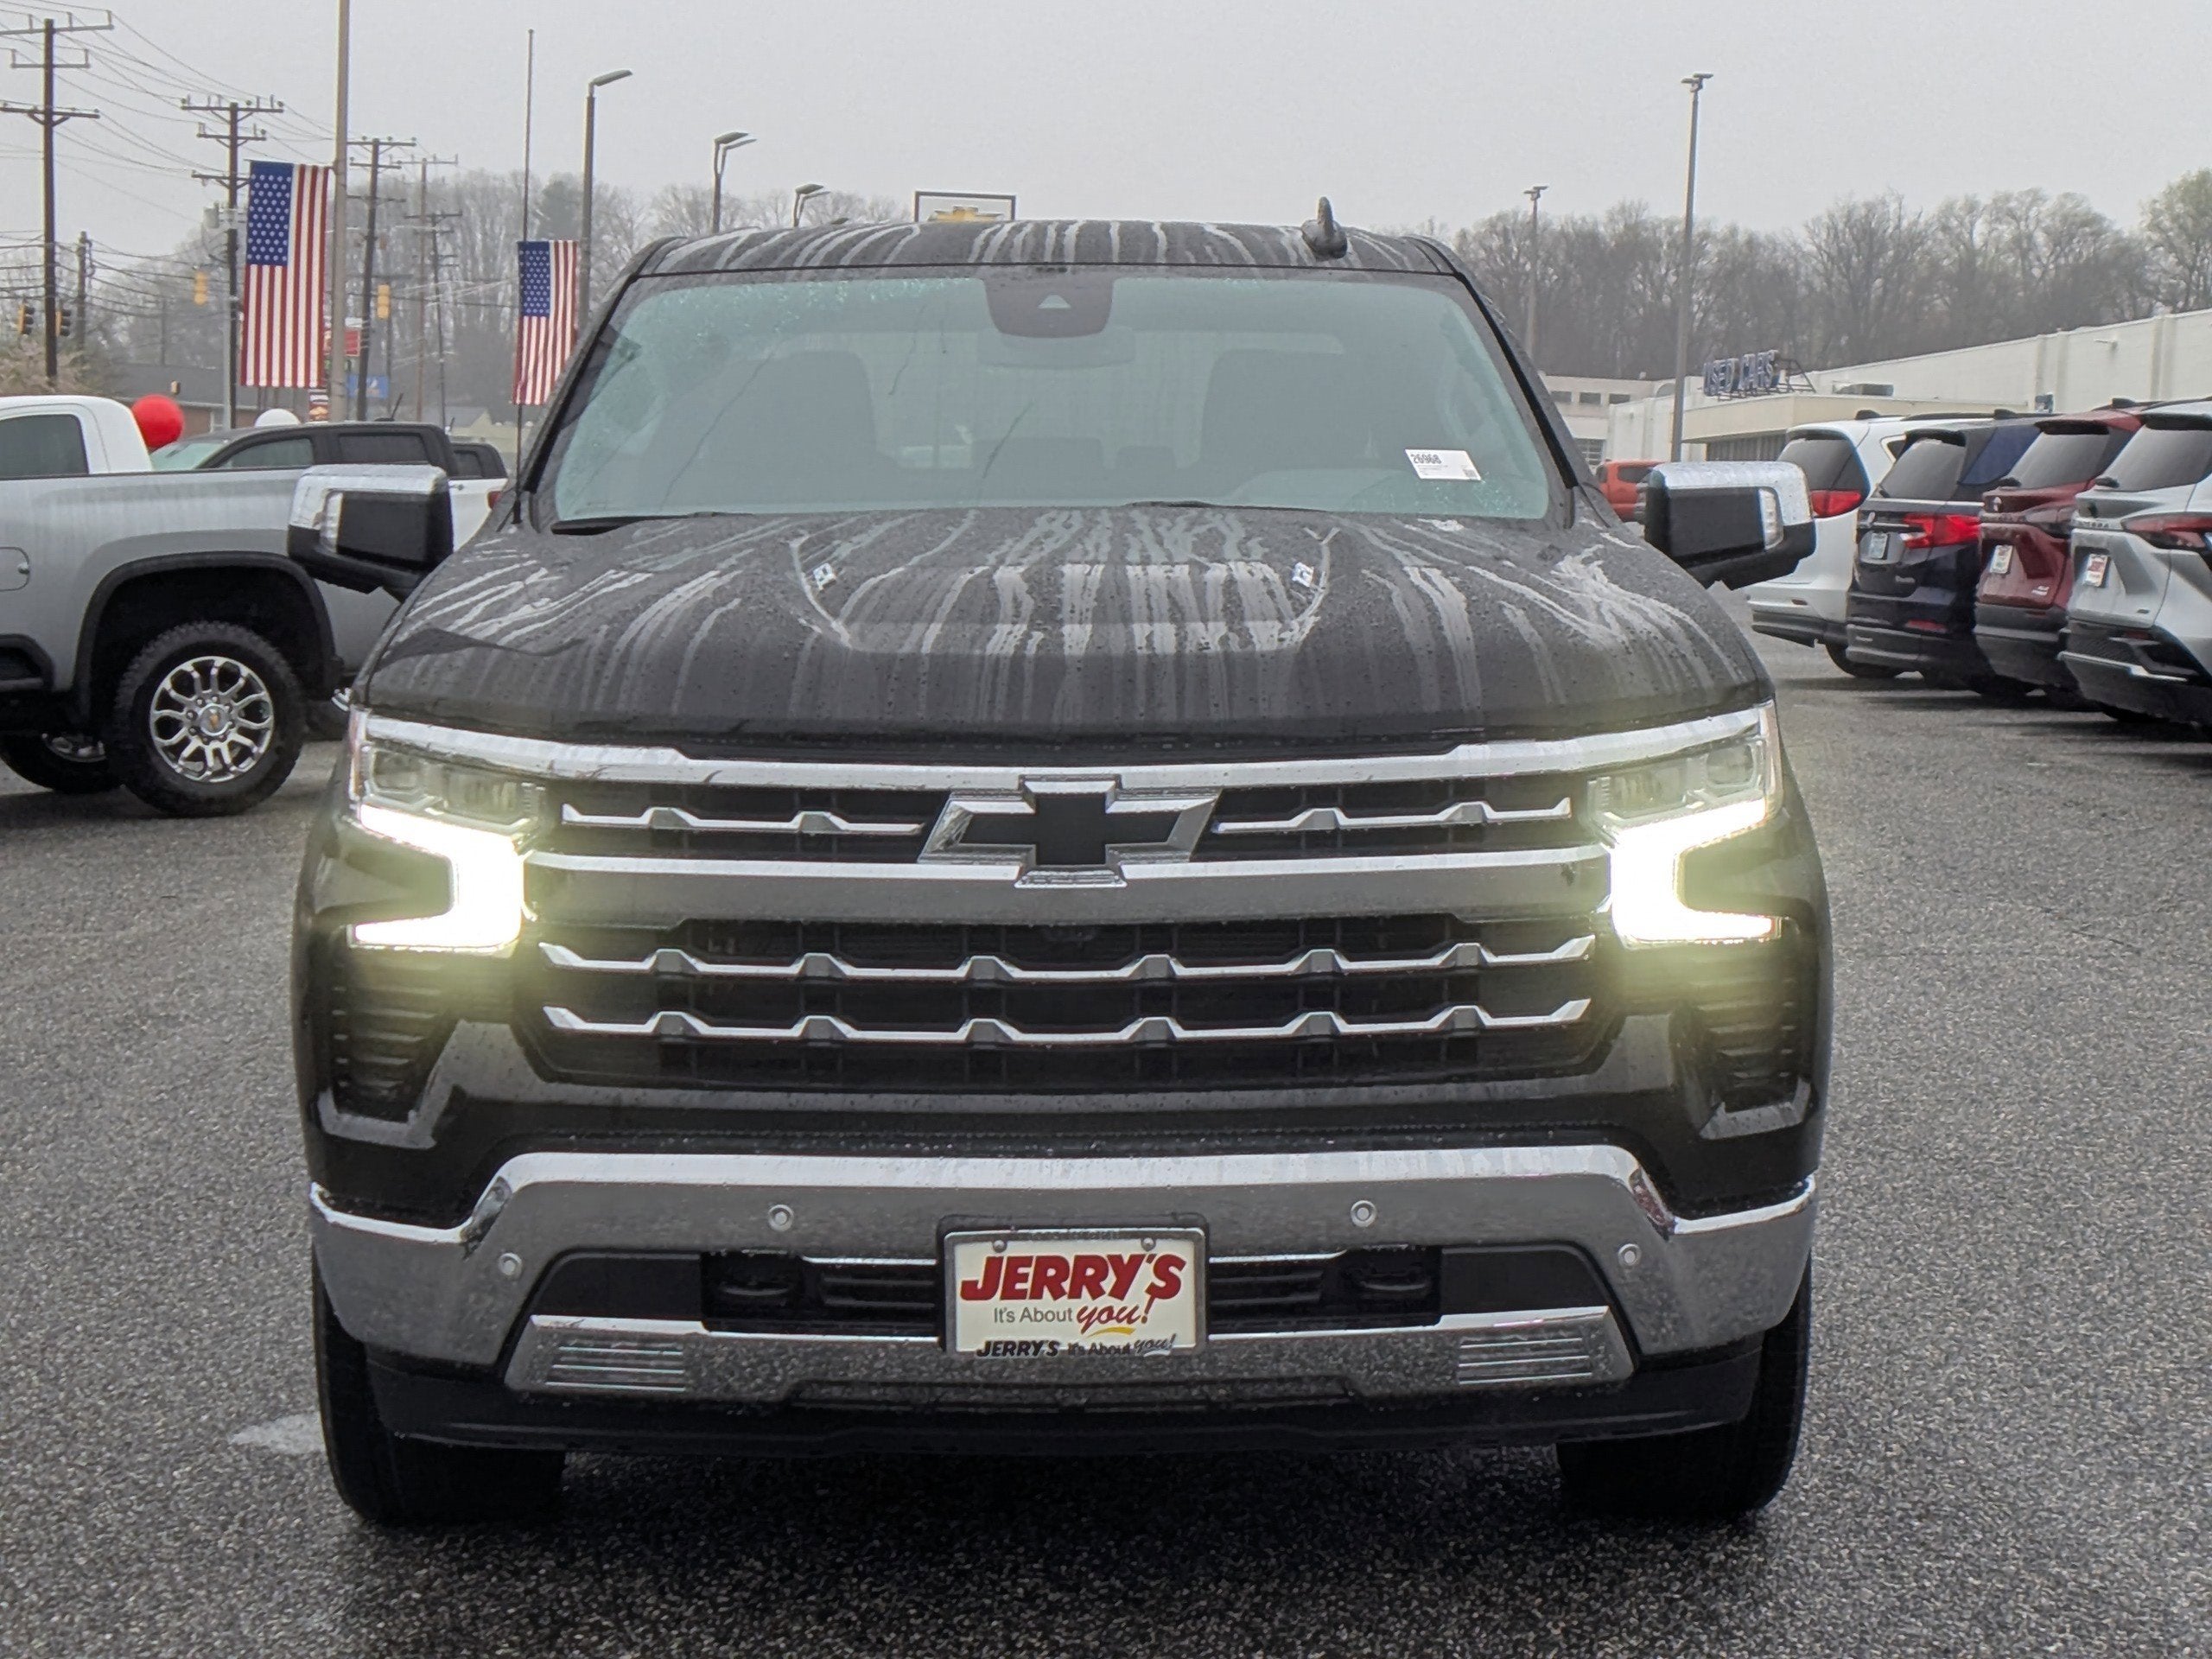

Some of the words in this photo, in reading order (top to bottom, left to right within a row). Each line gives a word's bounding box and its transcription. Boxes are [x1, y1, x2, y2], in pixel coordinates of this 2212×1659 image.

[960, 1253, 1186, 1300] JERRY'S
[994, 1306, 1015, 1322] It's
[1020, 1306, 1073, 1323] About
[1077, 1294, 1154, 1334] you!
[976, 1340, 1059, 1357] JERRY'S
[1086, 1342, 1131, 1355] About
[1133, 1333, 1177, 1351] you!
